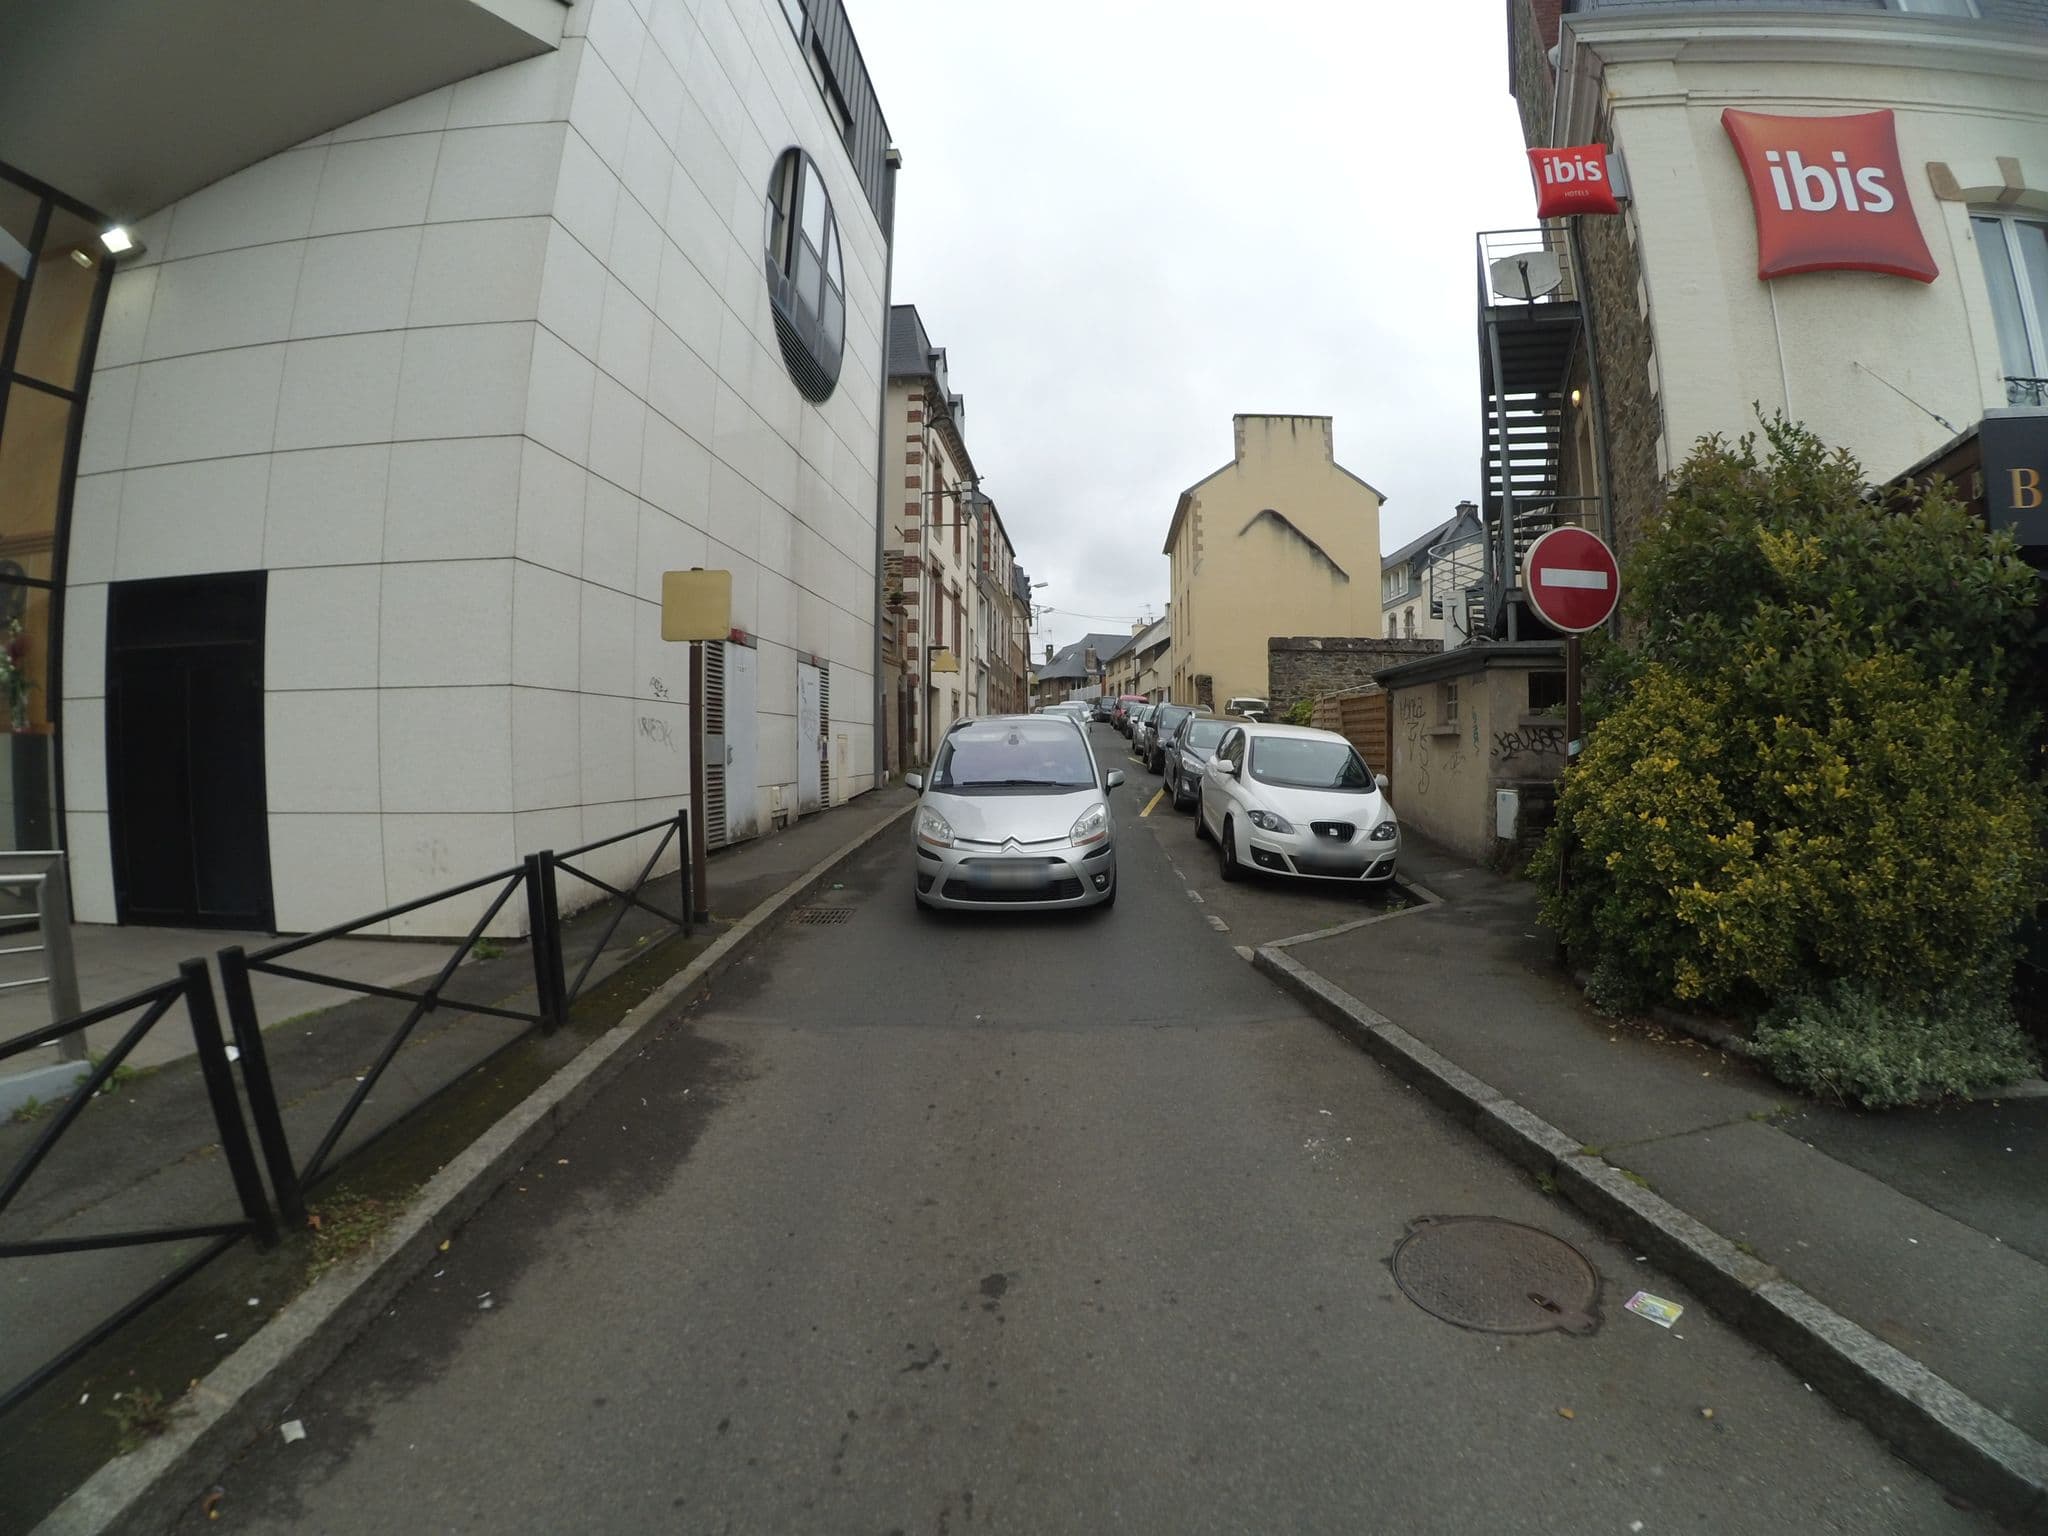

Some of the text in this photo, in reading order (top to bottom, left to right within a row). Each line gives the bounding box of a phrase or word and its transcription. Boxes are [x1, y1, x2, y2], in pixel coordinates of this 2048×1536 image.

[1542, 154, 1602, 185] ibis
[1765, 150, 1894, 213] ibis
[1564, 189, 1590, 198] HOTELS
[2005, 467, 2043, 509] B
